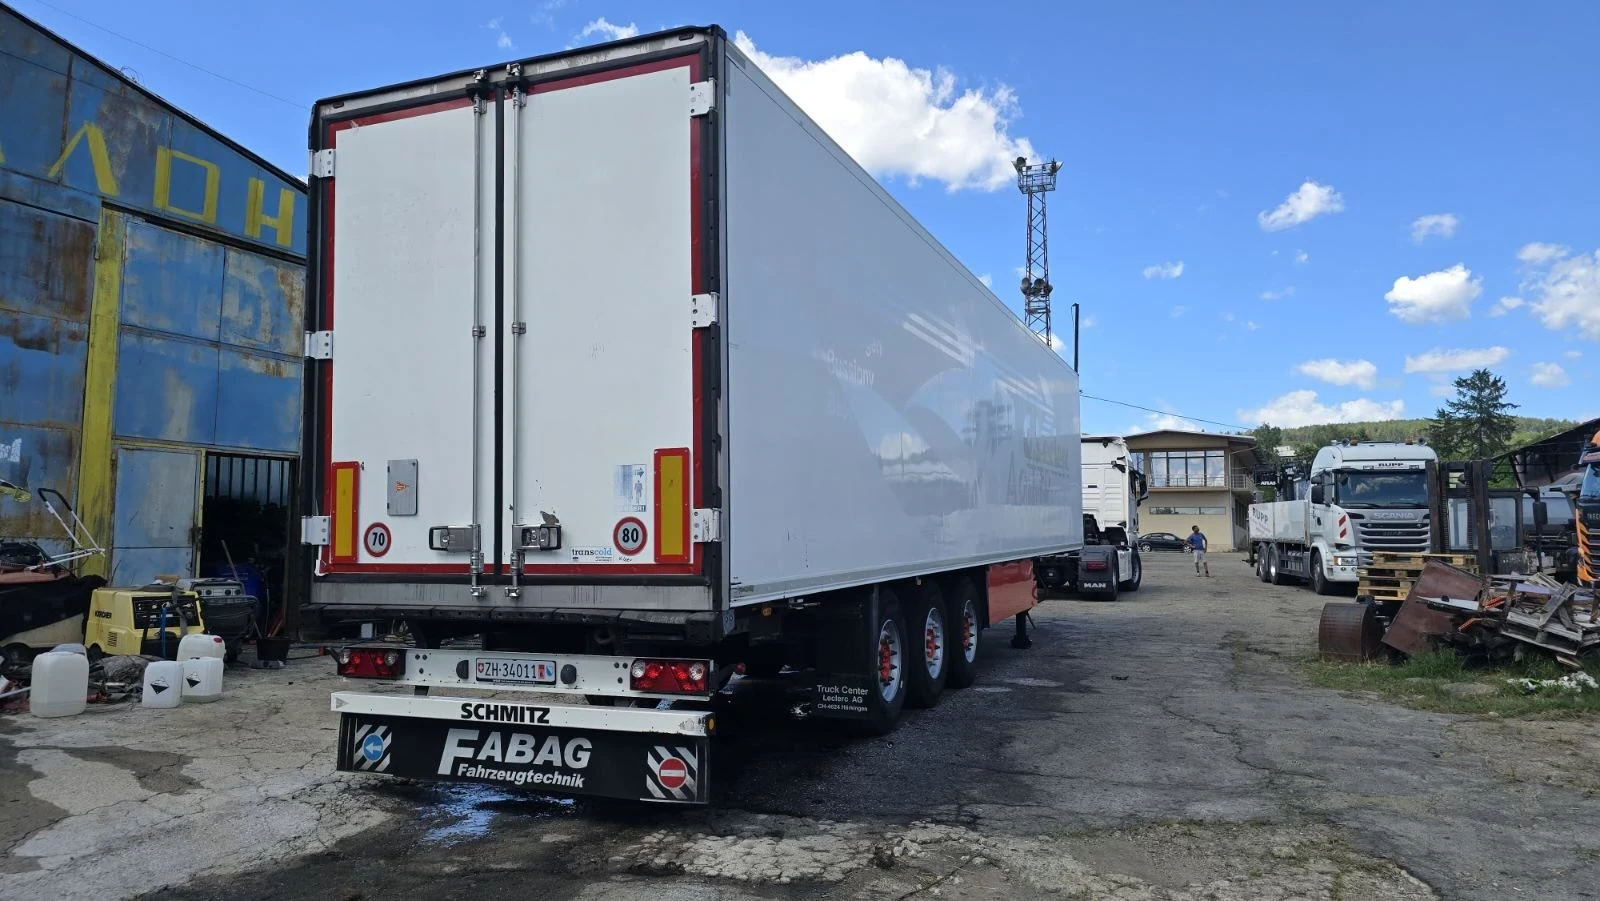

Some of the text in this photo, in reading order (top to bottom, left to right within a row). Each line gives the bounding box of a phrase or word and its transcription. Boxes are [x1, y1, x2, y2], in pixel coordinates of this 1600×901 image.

[1373, 512, 1415, 520] SCANIA
[372, 532, 385, 546] 70
[622, 528, 639, 543] 80
[572, 547, 612, 556] transcold
[816, 684, 869, 696] Truck Center
[852, 696, 863, 704] AG
[461, 703, 550, 724] SCHMITZ
[437, 728, 593, 775] FABAG
[458, 763, 585, 788] Fahrzeugtechnik
